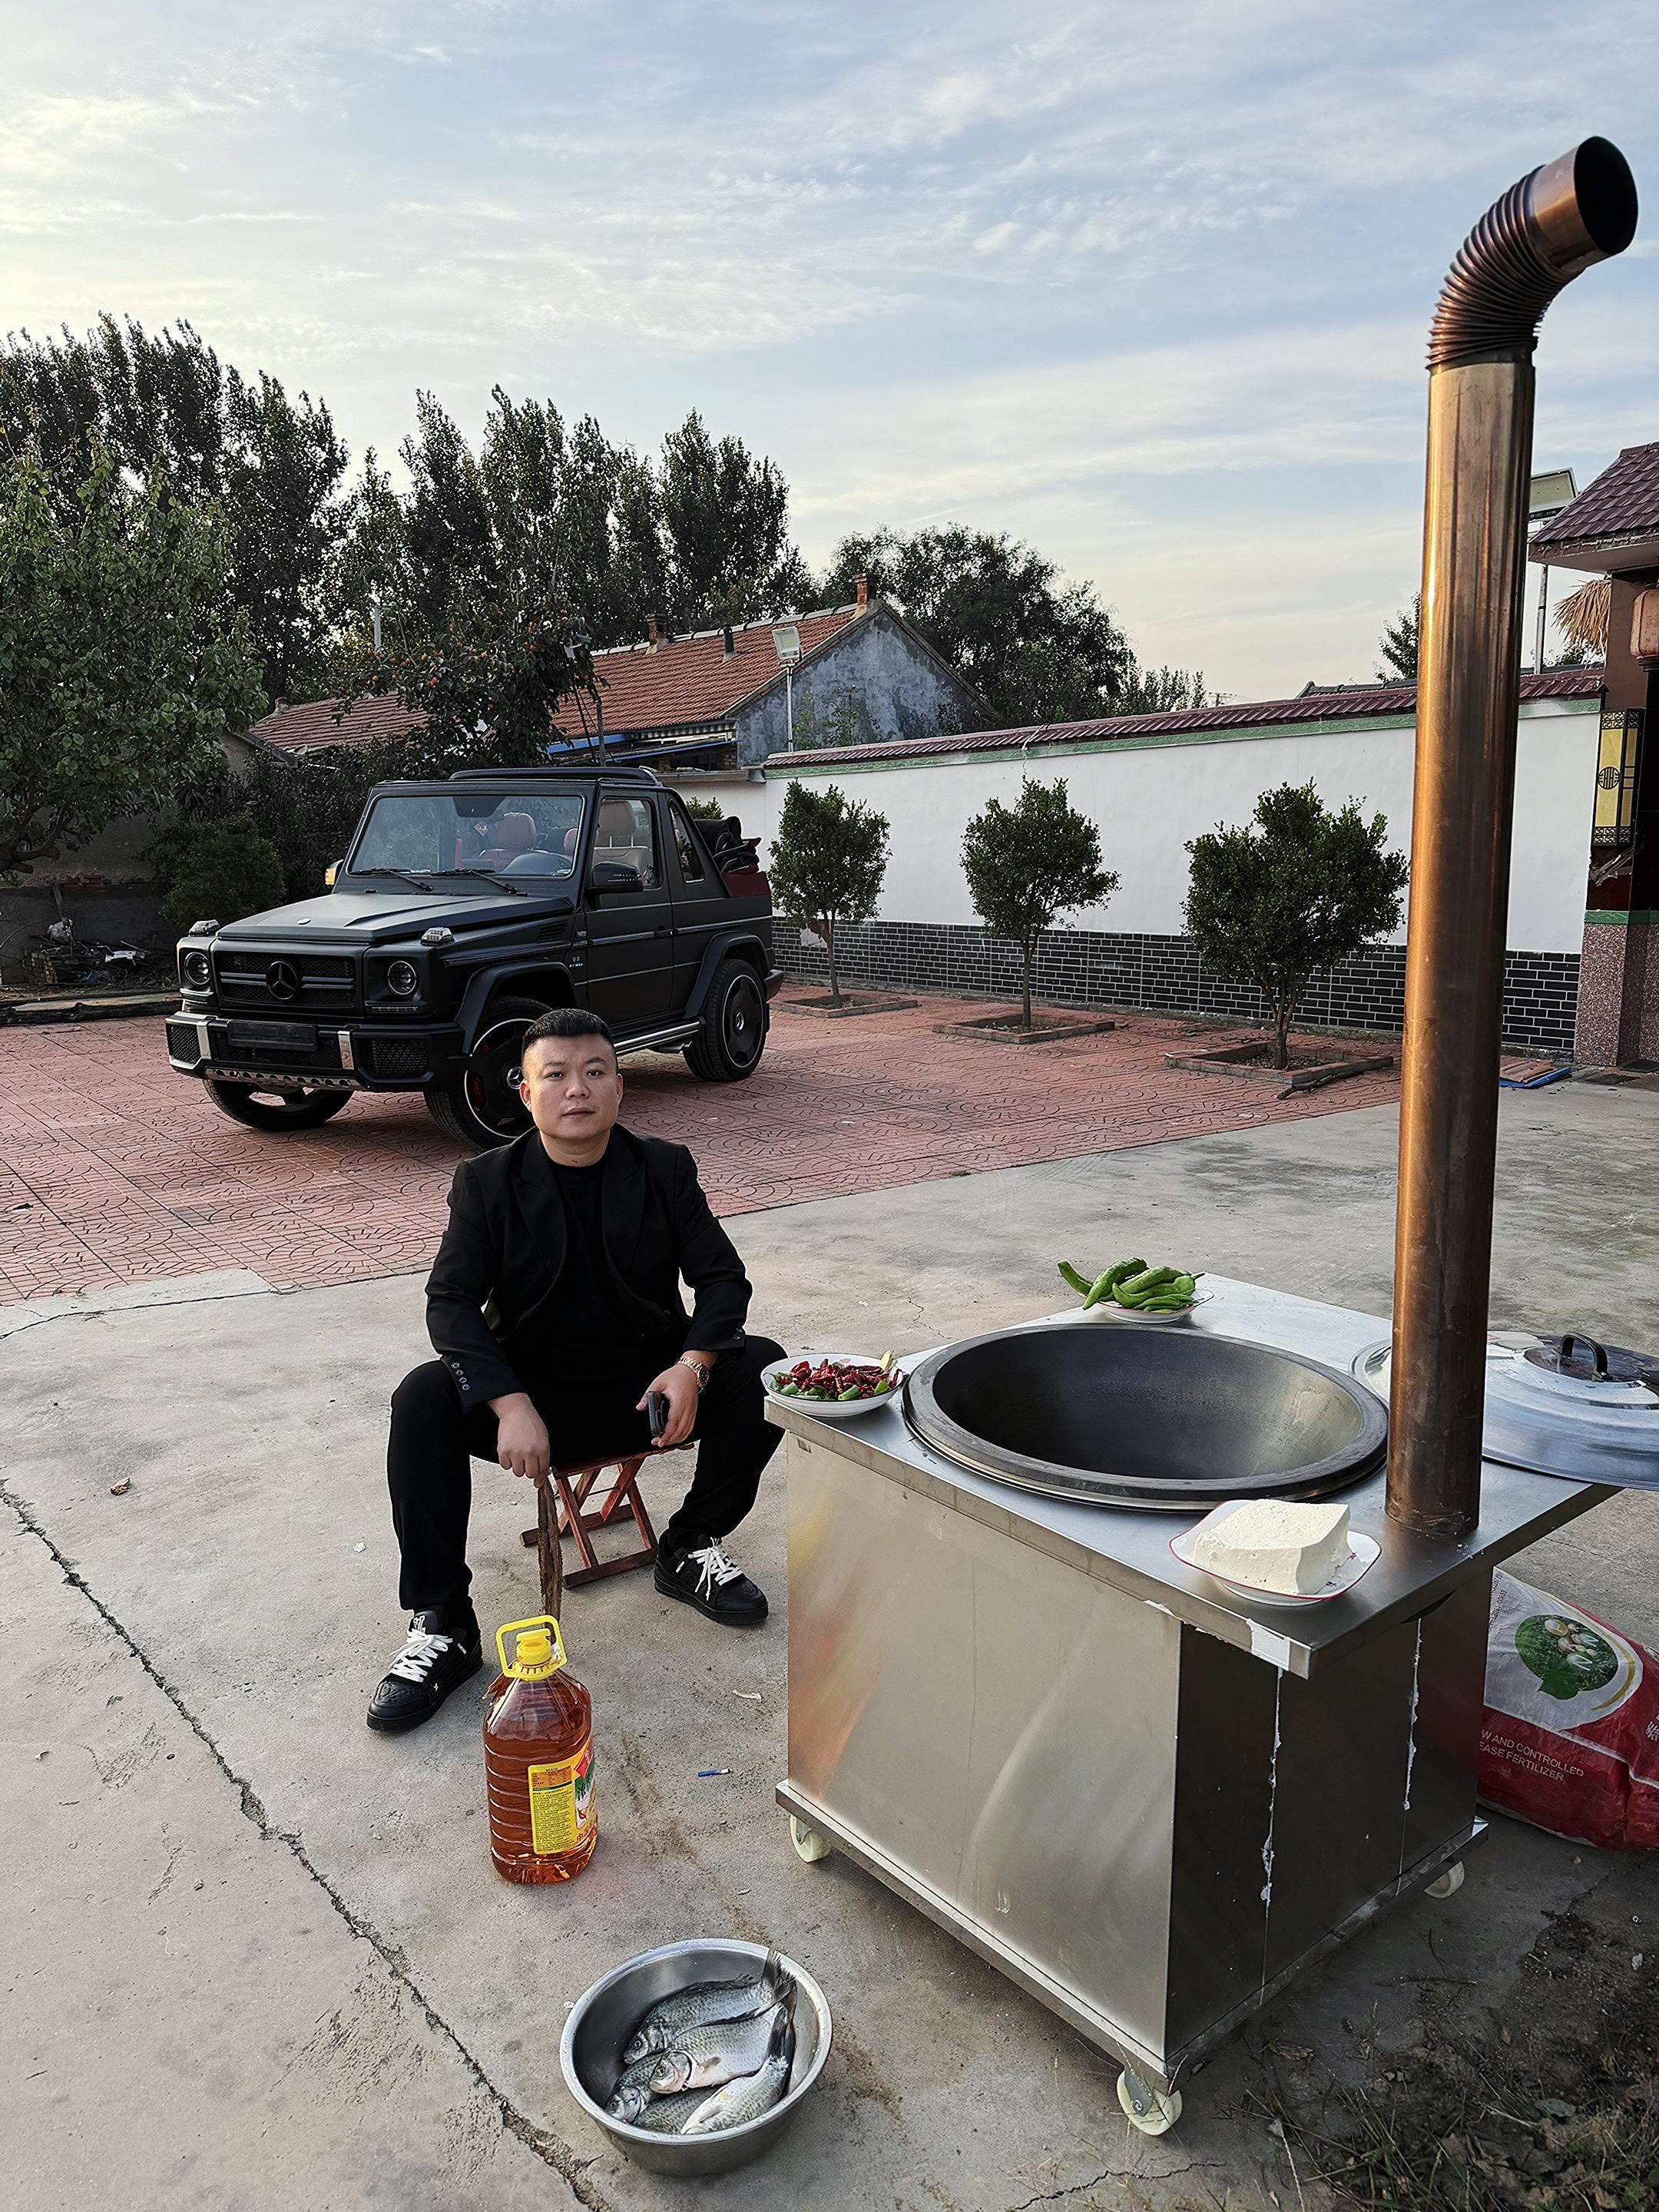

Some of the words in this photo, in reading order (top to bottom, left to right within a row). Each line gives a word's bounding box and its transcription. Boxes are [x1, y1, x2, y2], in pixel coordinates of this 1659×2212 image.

[1492, 1735, 1515, 1748] AND
[1516, 1743, 1584, 1777] CONTROLLED
[1505, 1751, 1565, 1781] FERTILIZER
